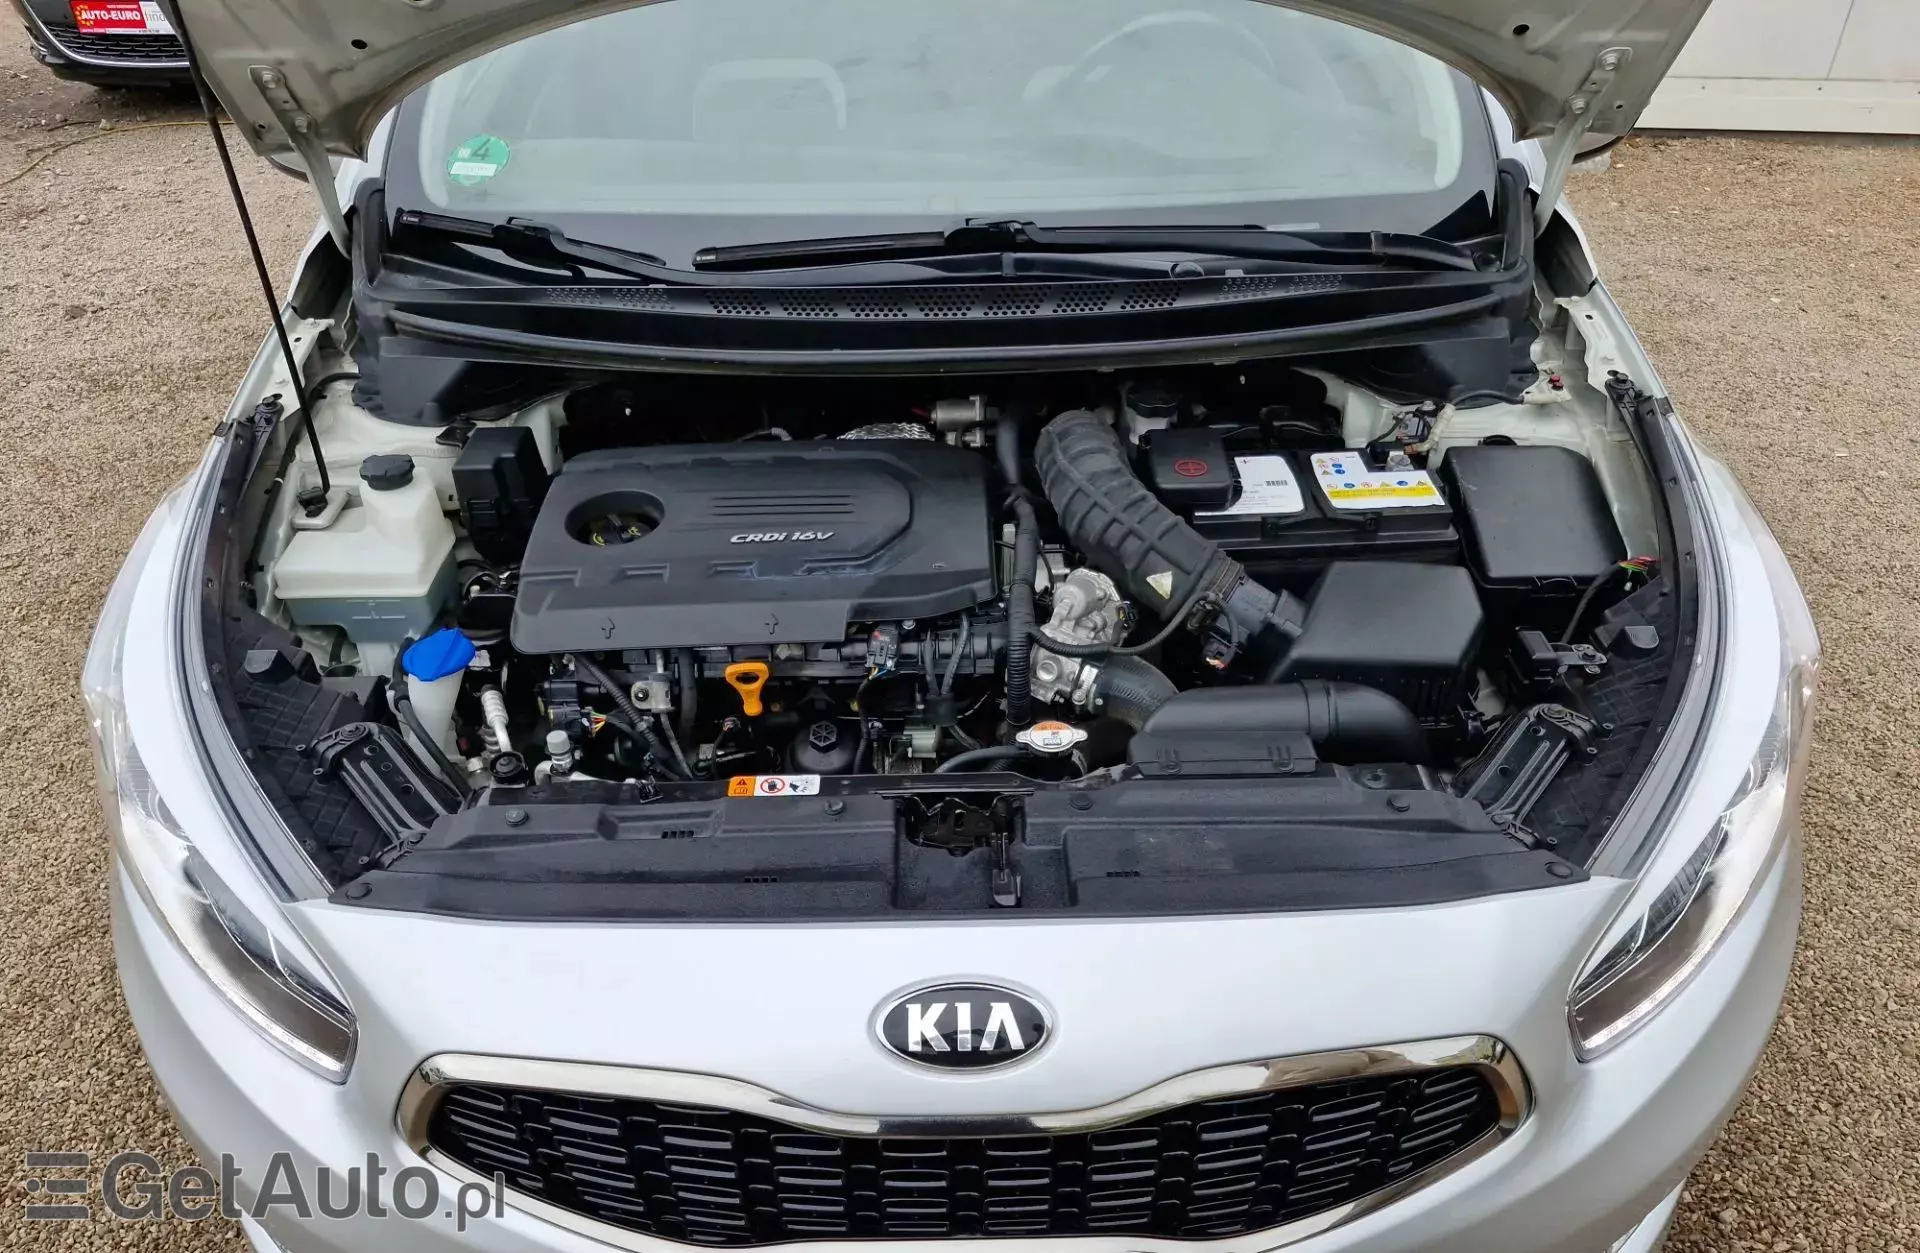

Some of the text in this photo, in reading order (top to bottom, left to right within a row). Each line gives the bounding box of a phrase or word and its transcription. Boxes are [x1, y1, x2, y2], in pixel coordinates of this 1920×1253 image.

[81, 10, 141, 20] AUTO-EURO
[471, 138, 492, 160] 4
[791, 531, 834, 541] 16V
[905, 1002, 1025, 1051] KIA
